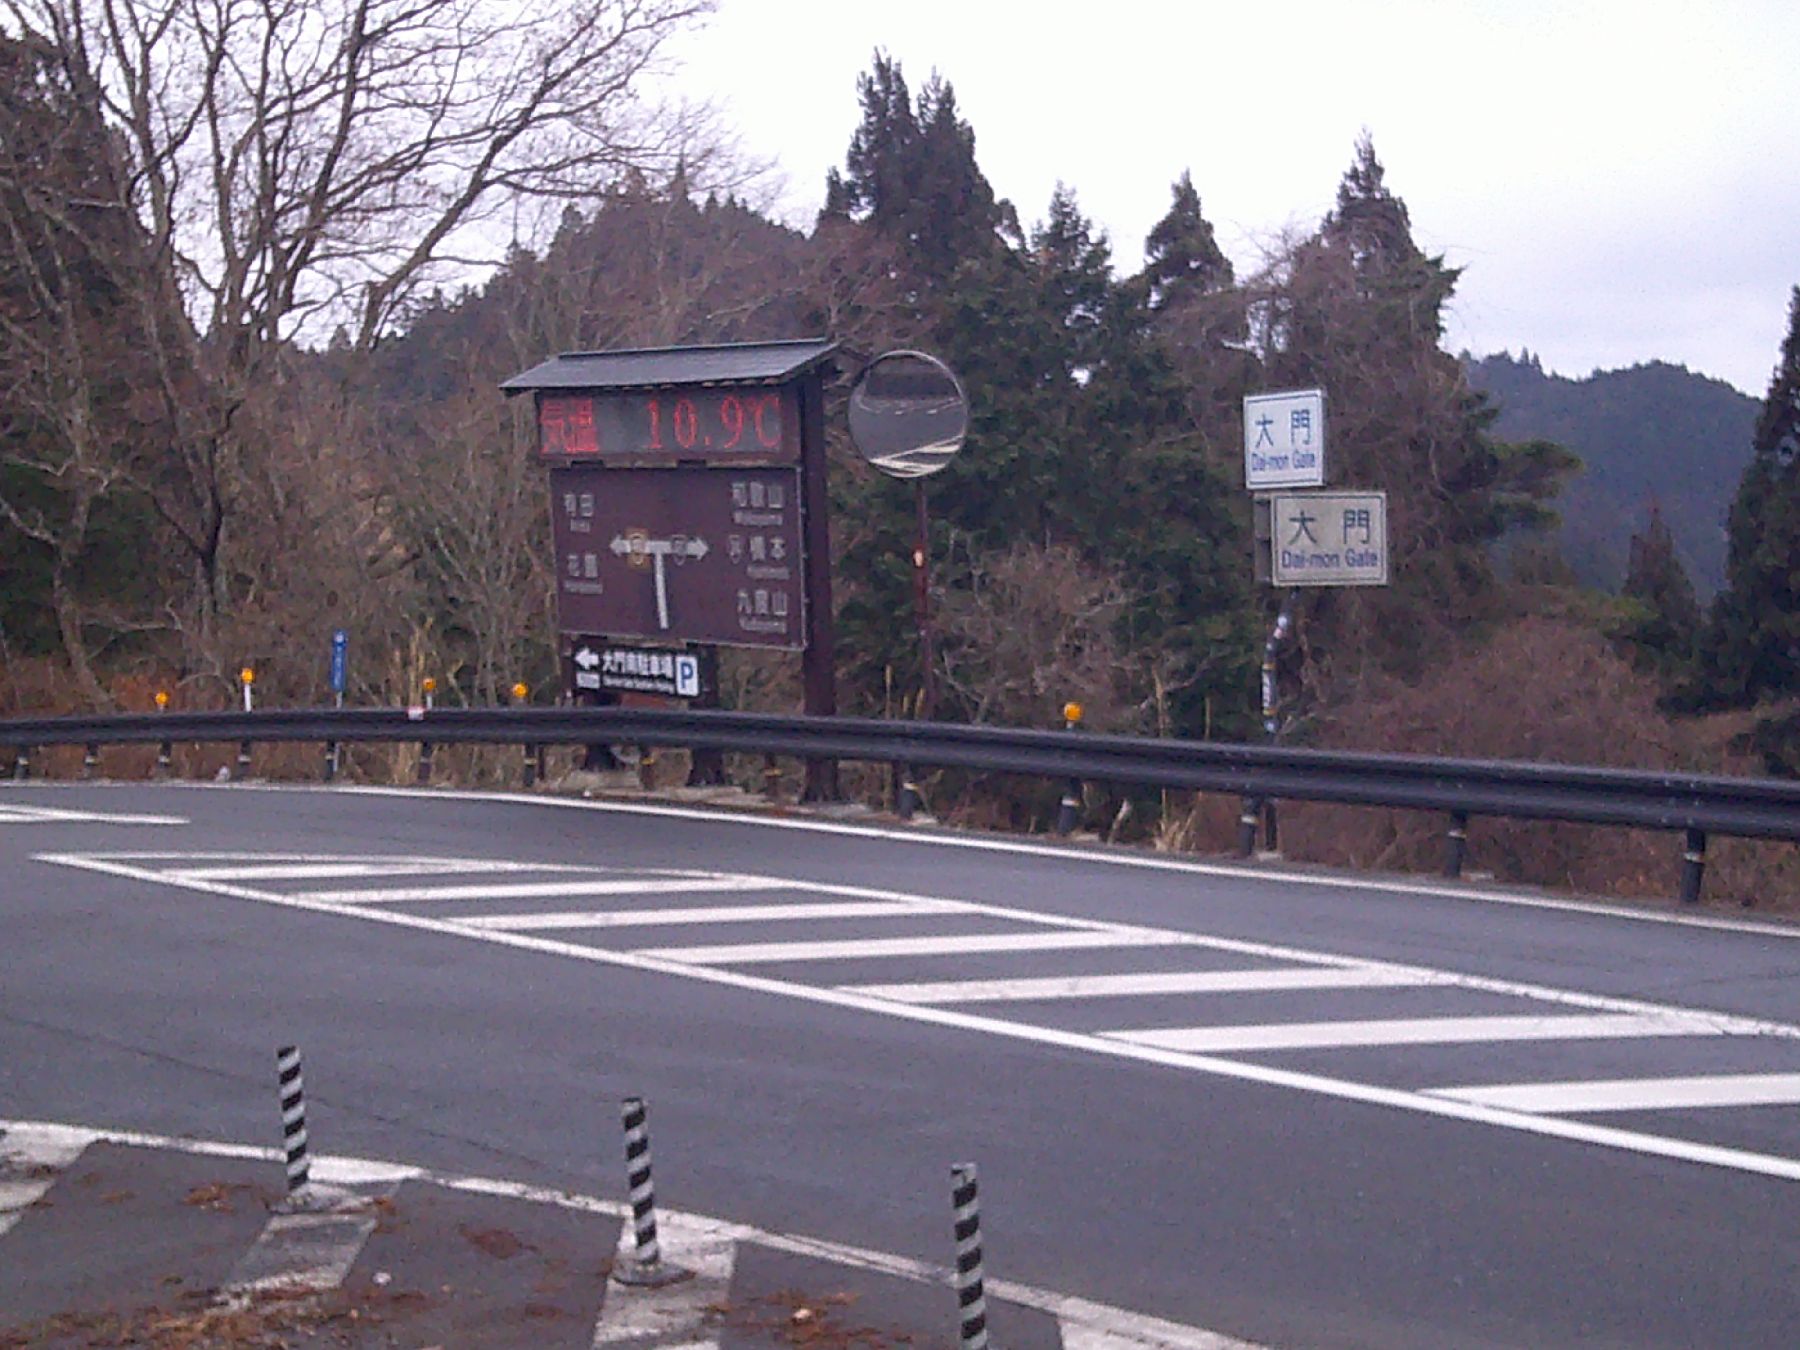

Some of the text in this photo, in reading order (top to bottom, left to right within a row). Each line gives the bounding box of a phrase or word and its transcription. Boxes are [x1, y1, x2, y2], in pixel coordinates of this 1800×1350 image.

[540, 397, 599, 455] 気温
[1255, 409, 1311, 448] 大門
[1292, 449, 1316, 469] Gate
[1288, 508, 1370, 545] 大門
[1281, 548, 1378, 569] Dai-mon Gate
[680, 661, 694, 689] P
